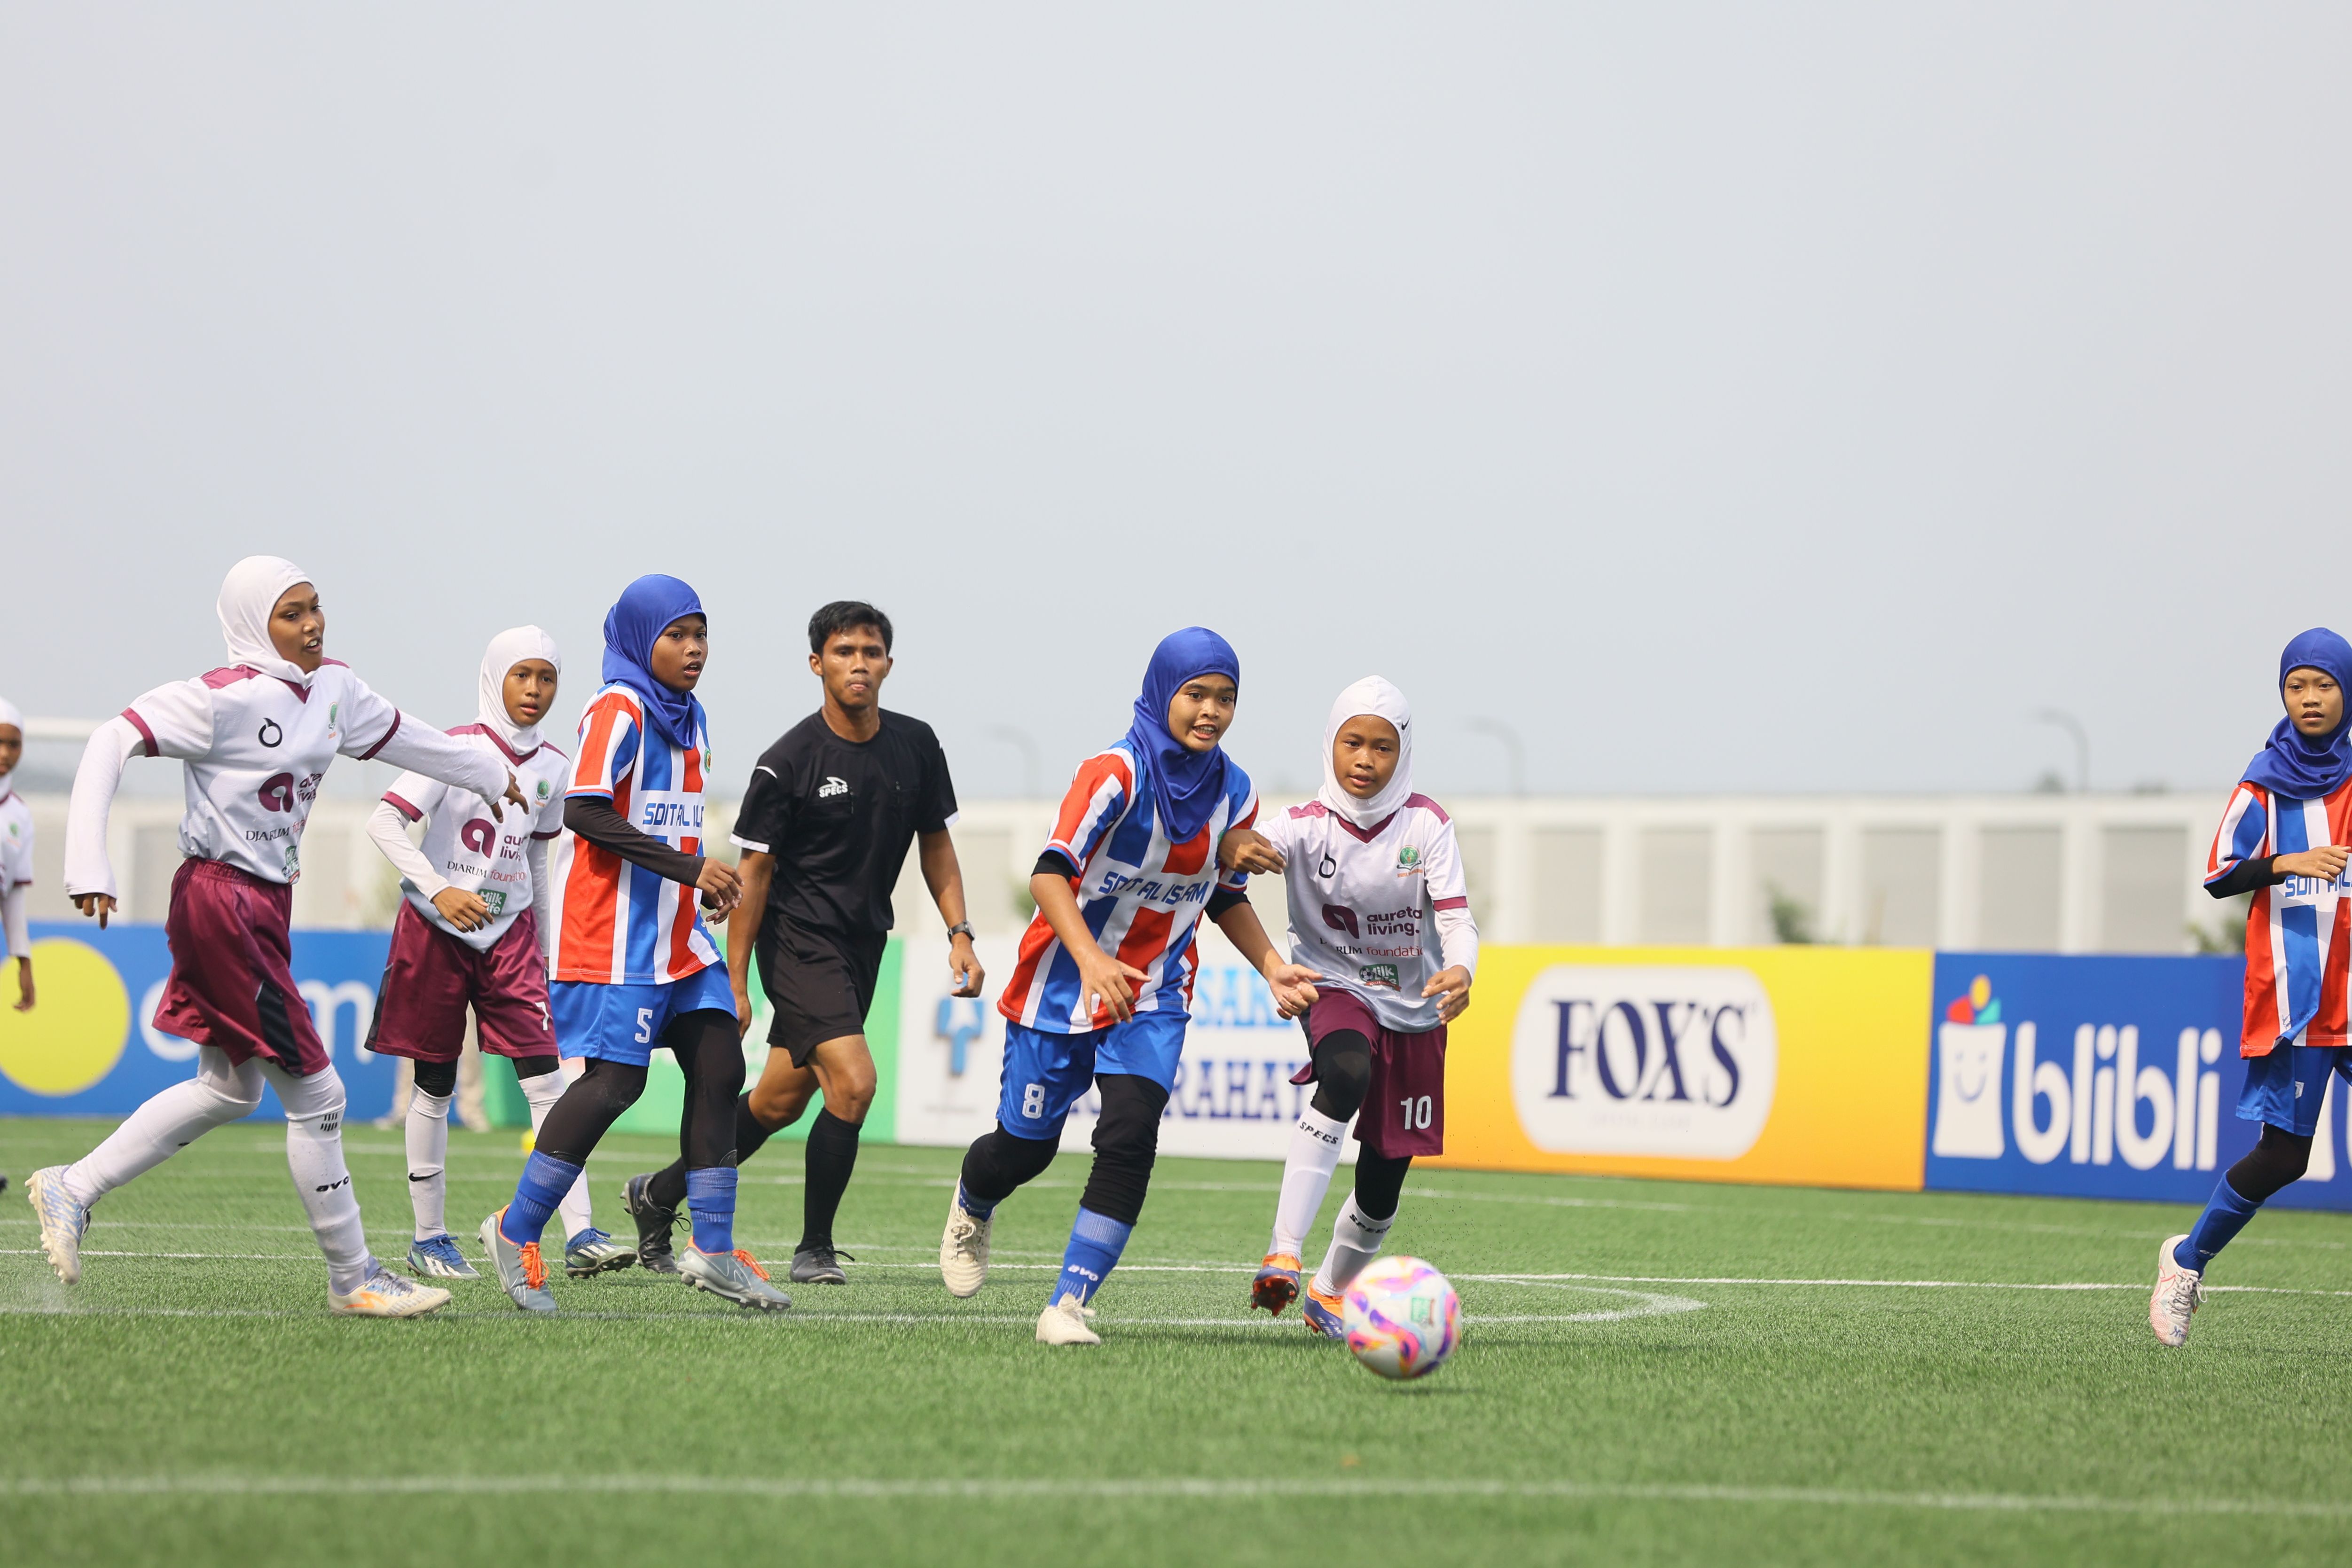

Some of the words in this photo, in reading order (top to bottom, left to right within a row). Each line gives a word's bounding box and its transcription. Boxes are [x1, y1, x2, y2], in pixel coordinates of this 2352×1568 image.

[819, 784, 848, 798] SPECS
[245, 827, 290, 842] DJARUM
[447, 861, 487, 878] DJARUM
[1366, 906, 1422, 922] aureta
[1367, 922, 1420, 936] living.
[1366, 946, 1423, 957] foundati
[534, 1001, 549, 1031] 7
[635, 1008, 653, 1044] 5
[1545, 999, 1744, 1108] FOX'S
[1022, 1083, 1045, 1119] 8
[2012, 1020, 2222, 1171] blibli
[1400, 1095, 1432, 1130] 10
[1300, 1121, 1339, 1145] SPECS
